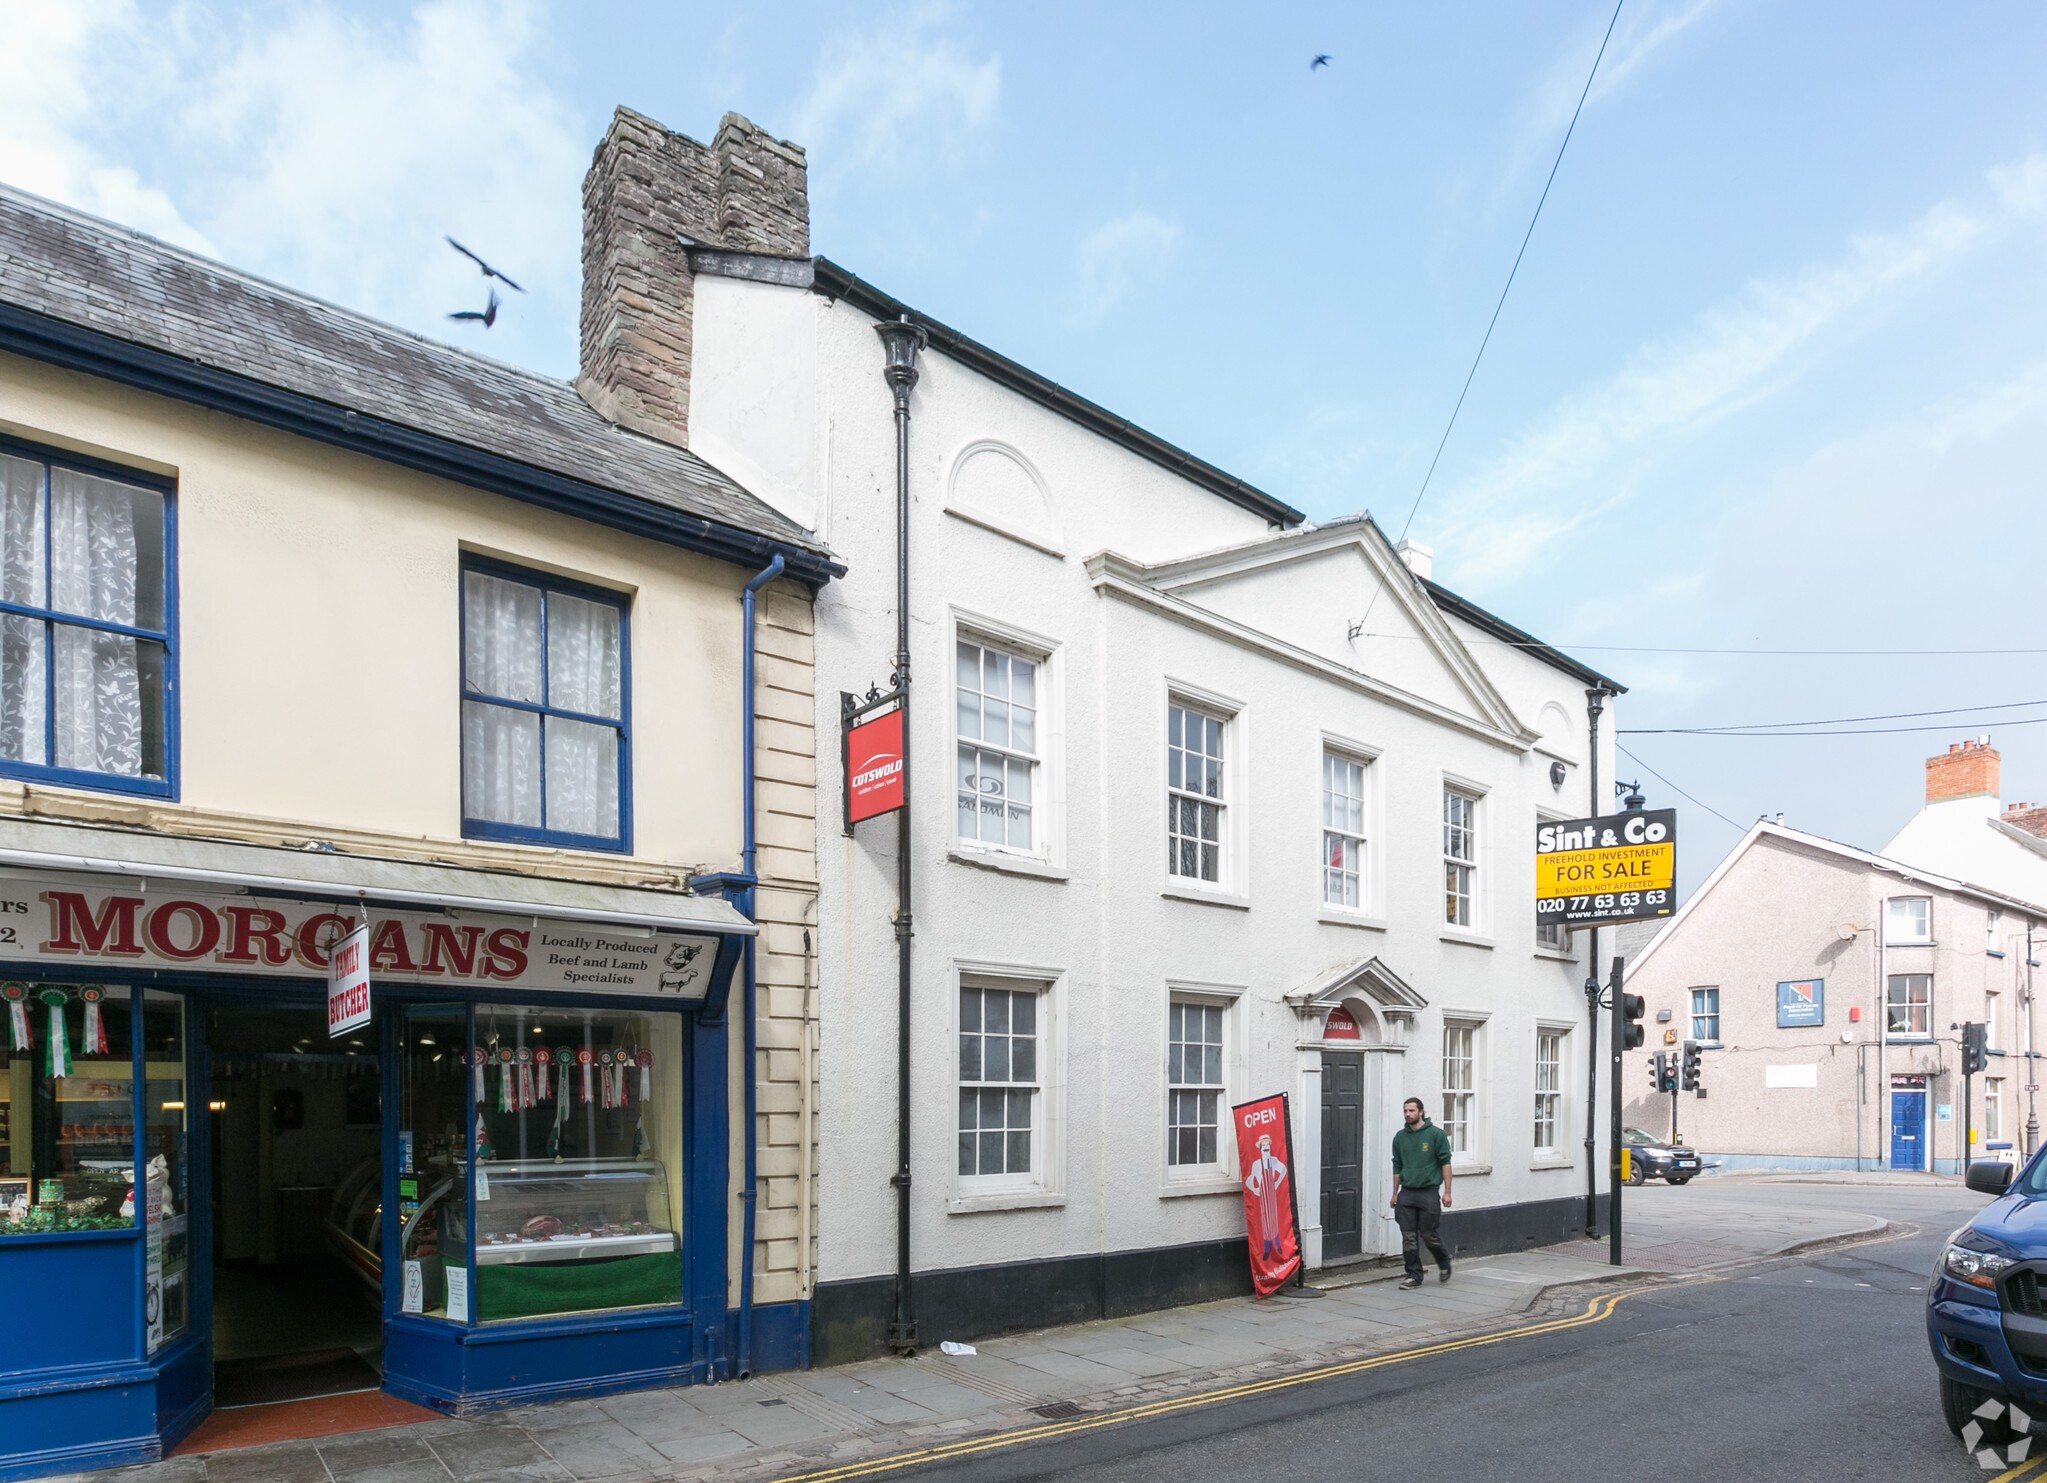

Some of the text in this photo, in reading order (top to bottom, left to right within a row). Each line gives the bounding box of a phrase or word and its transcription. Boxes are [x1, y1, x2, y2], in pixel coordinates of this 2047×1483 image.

[852, 759, 903, 788] COTSWOLD
[1538, 816, 1667, 853] Sint & Co
[1544, 847, 1665, 865] FREEHOLD INVESTMENT
[1556, 860, 1652, 882] FOR SALE
[1554, 880, 1654, 895] BUSINESS NOT AFFECTED
[1537, 890, 1666, 913] 020 77 63 63 63
[1566, 907, 1635, 919] www.sint.co.uk
[40, 890, 532, 982] MORGANS
[541, 934, 659, 954] Locally Produced
[335, 941, 360, 981] FAMILY
[549, 953, 649, 971] Beef and Lamb
[563, 970, 635, 985] Specialists
[329, 981, 369, 1025] BUTCHER
[1244, 1107, 1277, 1128] OPEN
